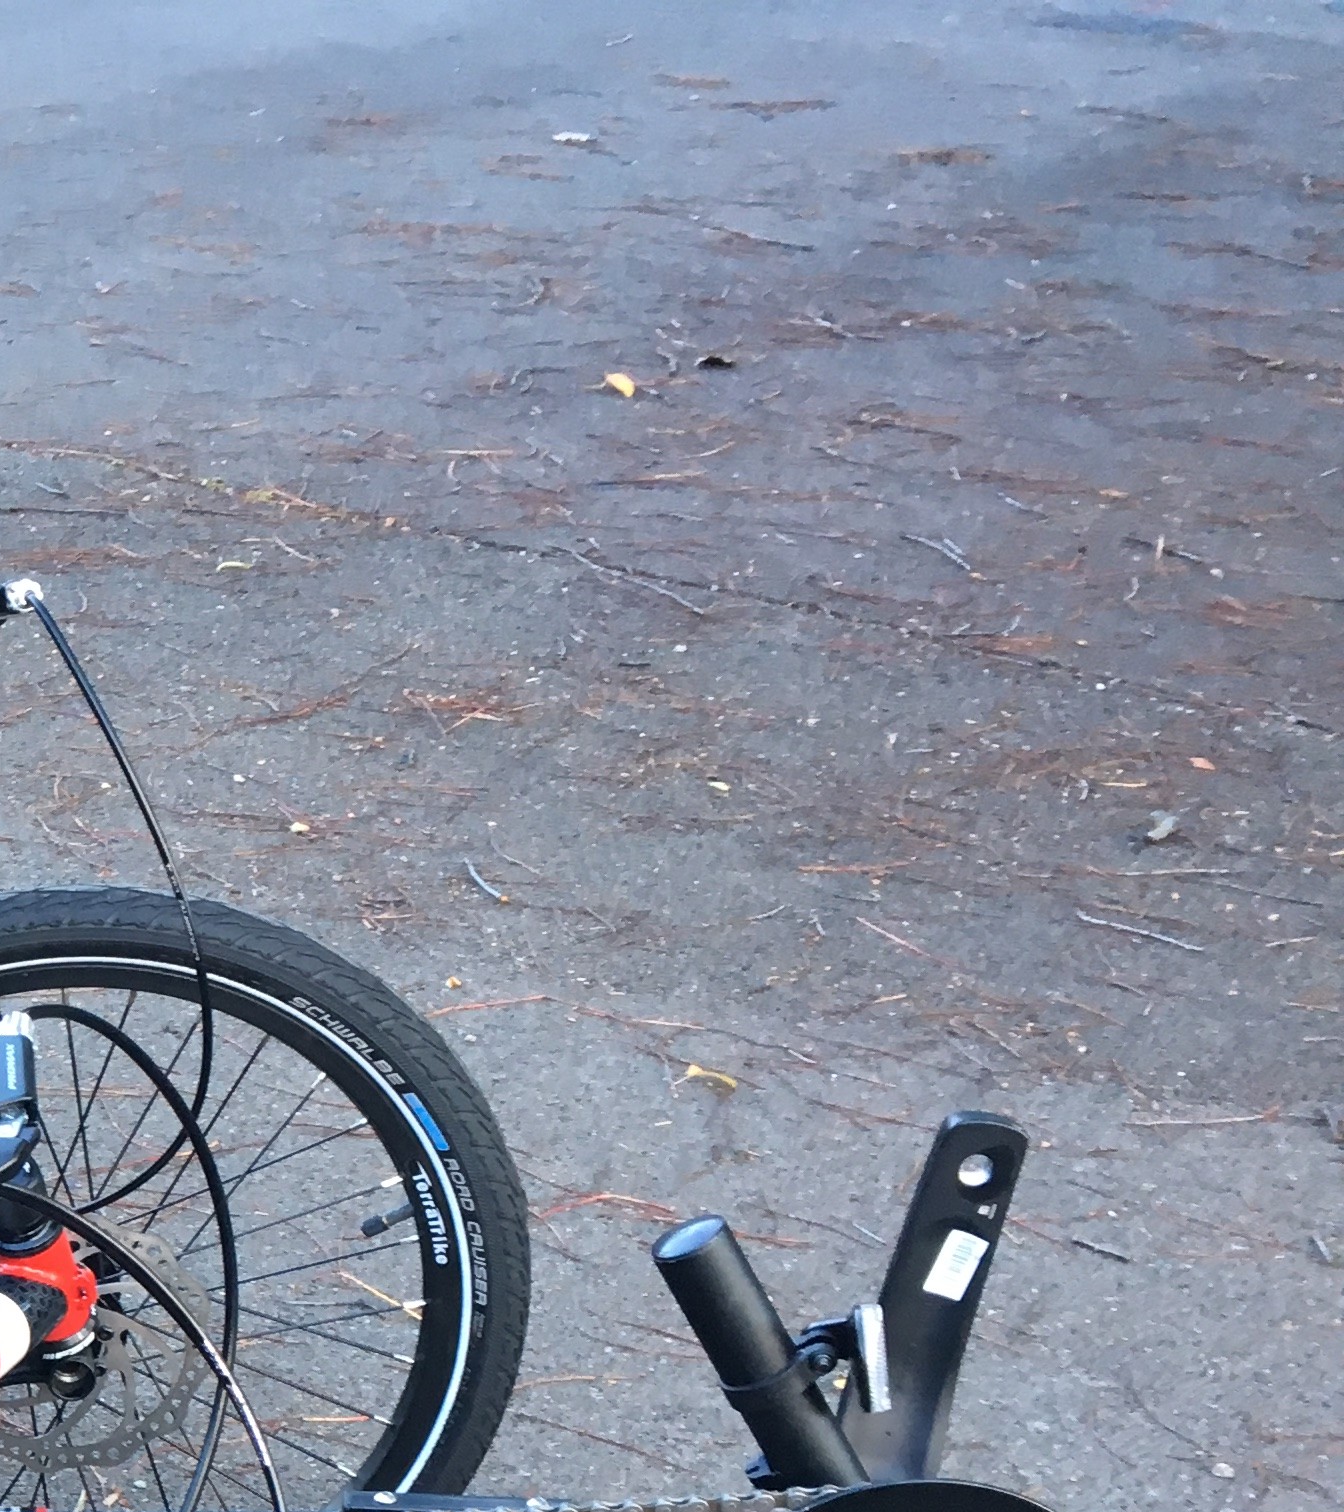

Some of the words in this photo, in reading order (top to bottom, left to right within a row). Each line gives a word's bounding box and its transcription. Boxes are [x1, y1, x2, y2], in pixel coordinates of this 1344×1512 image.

[288, 996, 406, 1086] SCHWALBE
[443, 1157, 475, 1212] ROAD
[466, 1219, 488, 1306] CRUISER
[412, 1160, 449, 1265] TerraTrike
